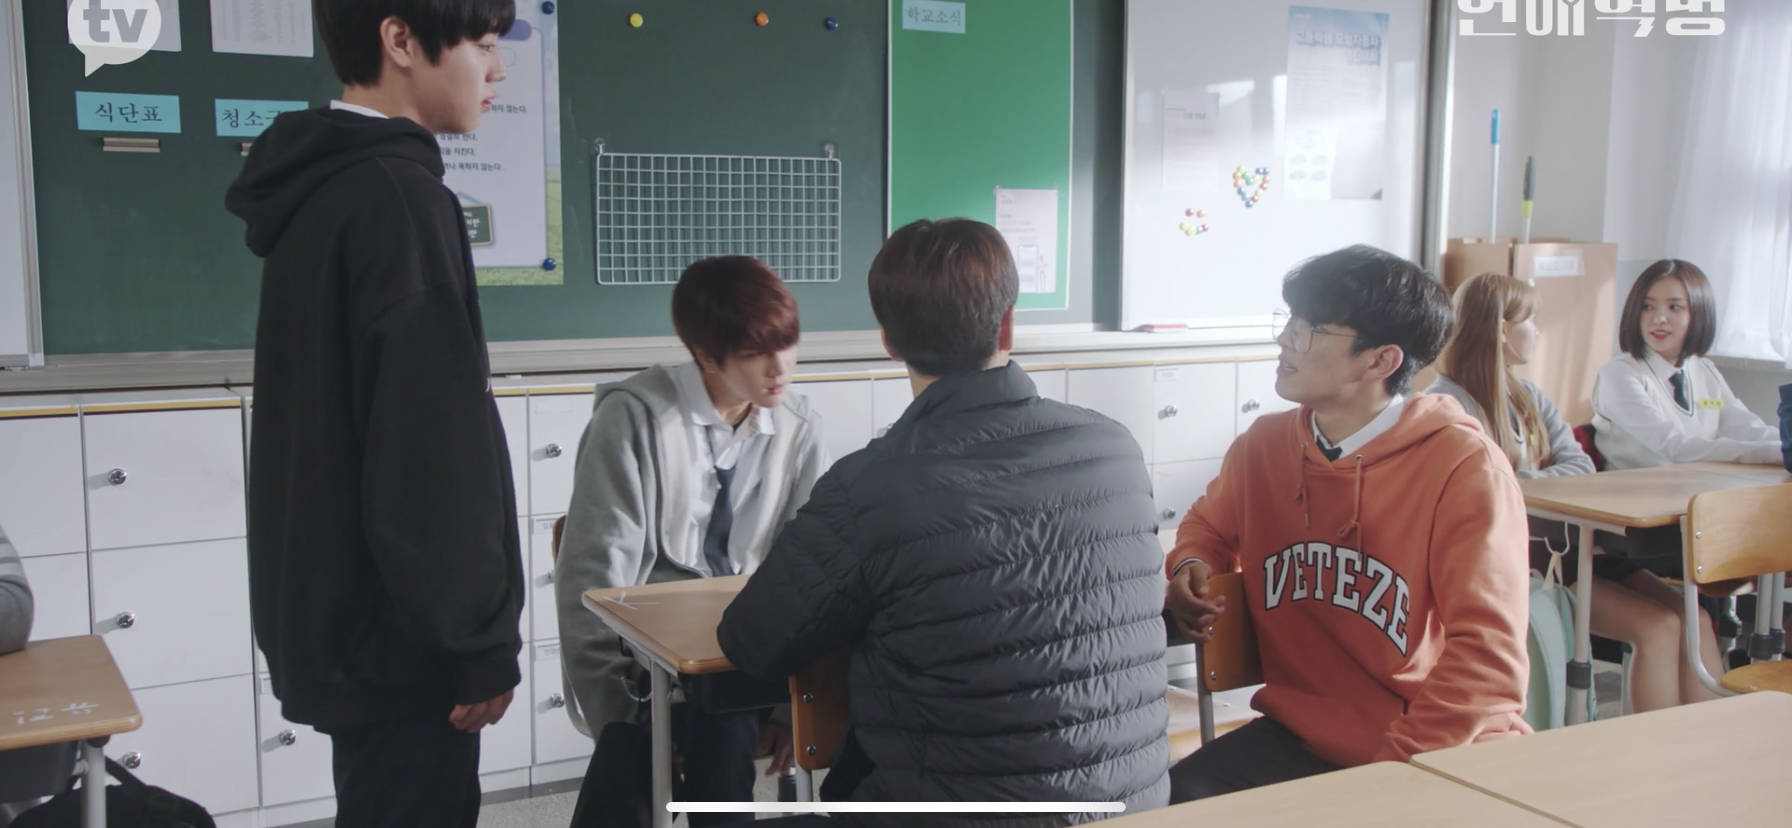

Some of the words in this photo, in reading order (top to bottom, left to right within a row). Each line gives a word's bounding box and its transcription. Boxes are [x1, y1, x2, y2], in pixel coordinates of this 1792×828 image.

[906, 6, 961, 26] 학교소식
[94, 102, 163, 124] 식단표
[1263, 540, 1410, 658] VETEZE
